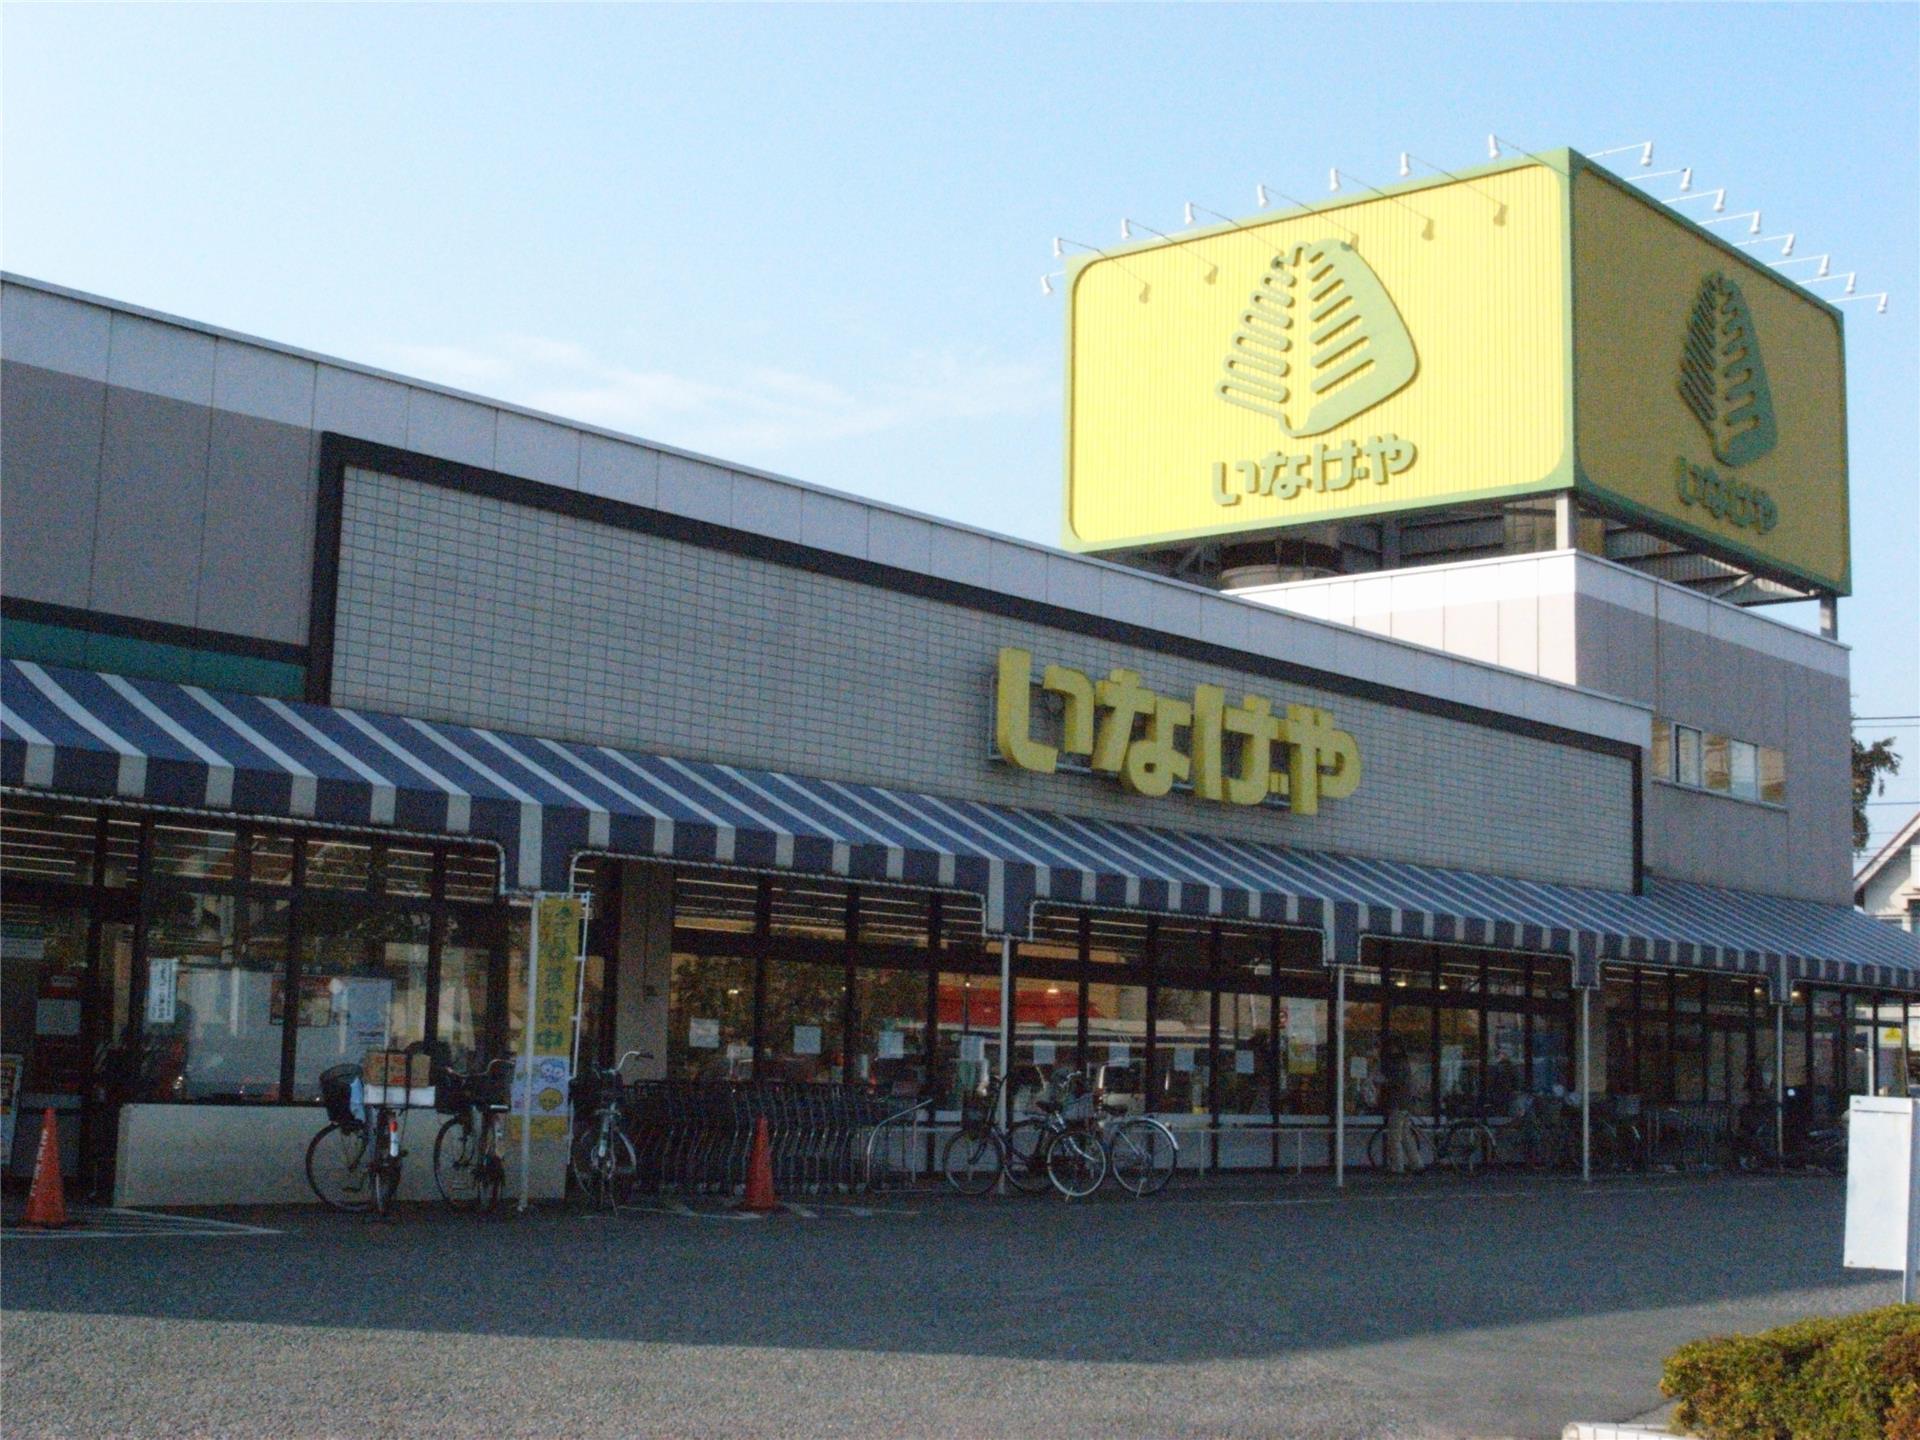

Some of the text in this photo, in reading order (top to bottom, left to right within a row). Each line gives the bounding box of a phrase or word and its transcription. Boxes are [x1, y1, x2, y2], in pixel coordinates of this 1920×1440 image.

[1212, 433, 1417, 506] いなげや
[997, 647, 1361, 815] いなげや
